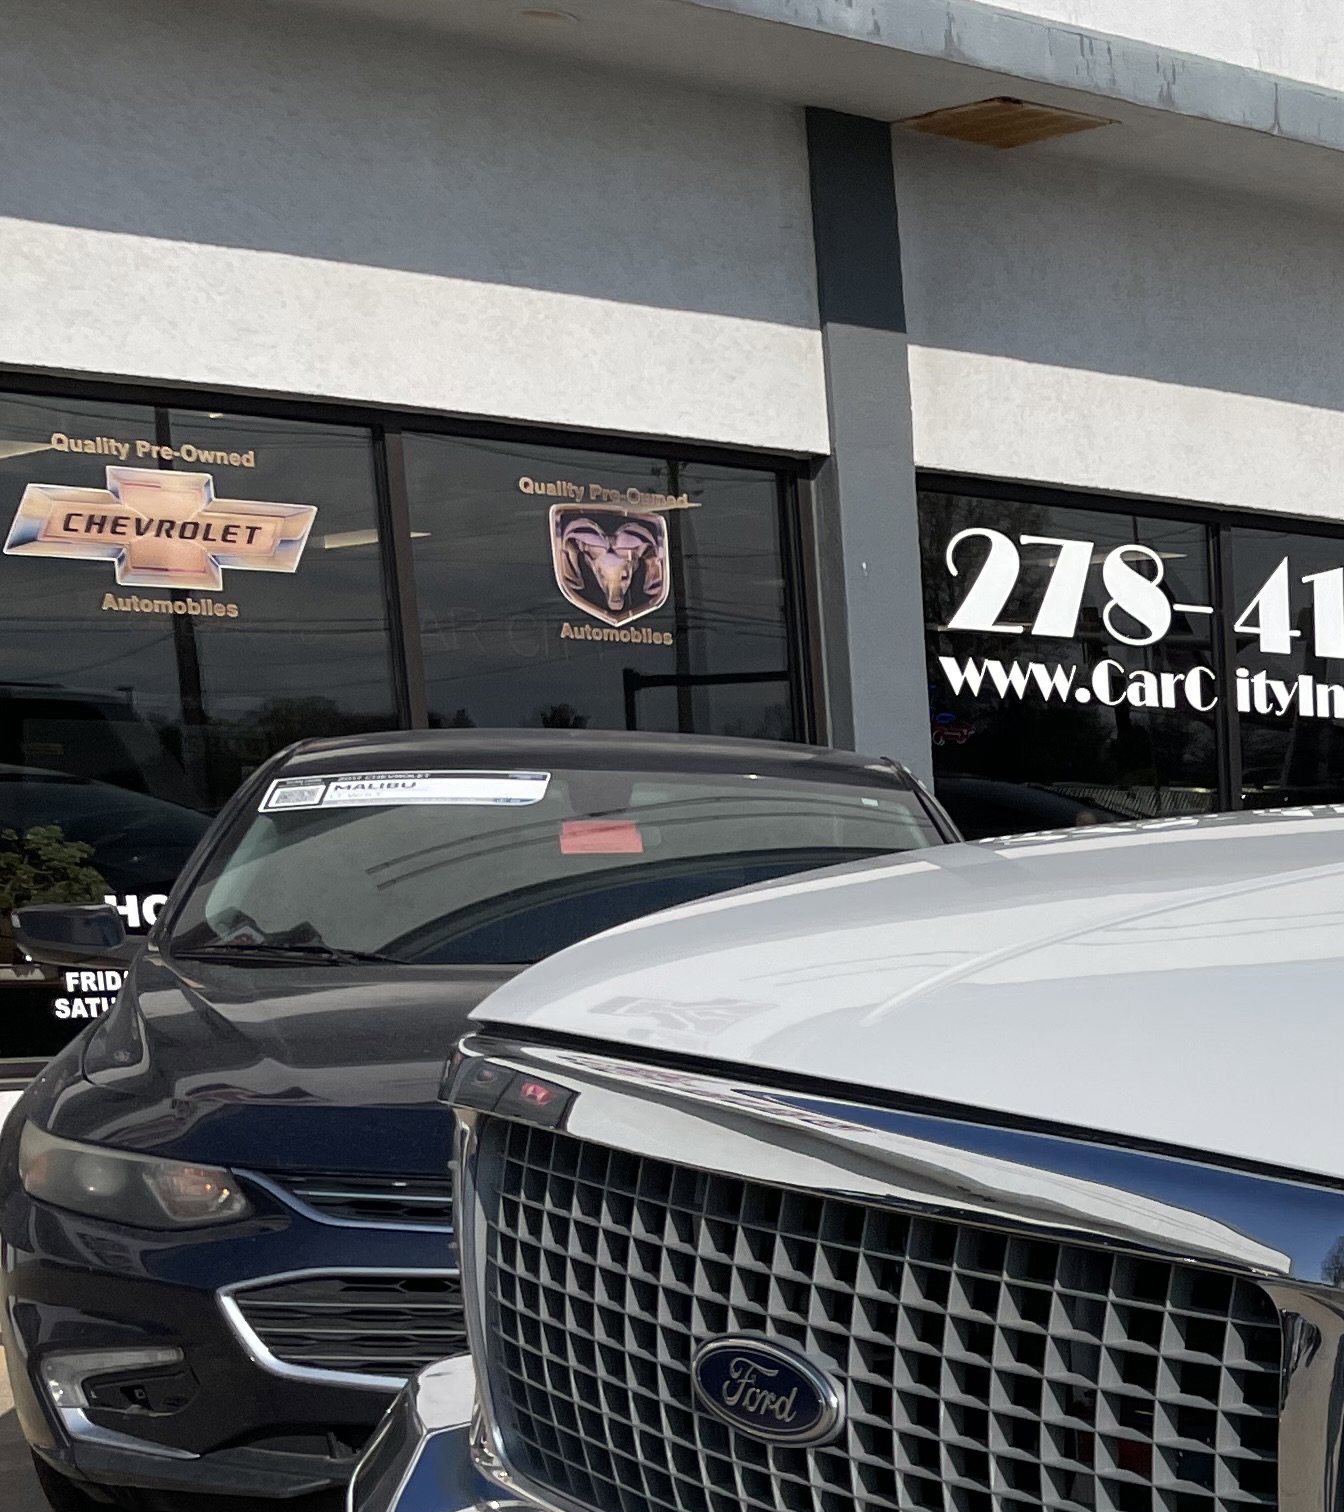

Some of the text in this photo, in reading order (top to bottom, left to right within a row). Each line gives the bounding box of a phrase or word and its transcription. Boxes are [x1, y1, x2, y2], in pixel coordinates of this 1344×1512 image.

[51, 433, 256, 468] Quality Pre-Owned
[518, 476, 689, 509] Quality Pre-Owned
[62, 511, 263, 545] CHEVROLET
[101, 593, 240, 618] Automobiles
[560, 622, 674, 646] Automobiles
[333, 781, 417, 792] MALIBU
[65, 970, 129, 993] FRID
[721, 1356, 799, 1423] Ford
